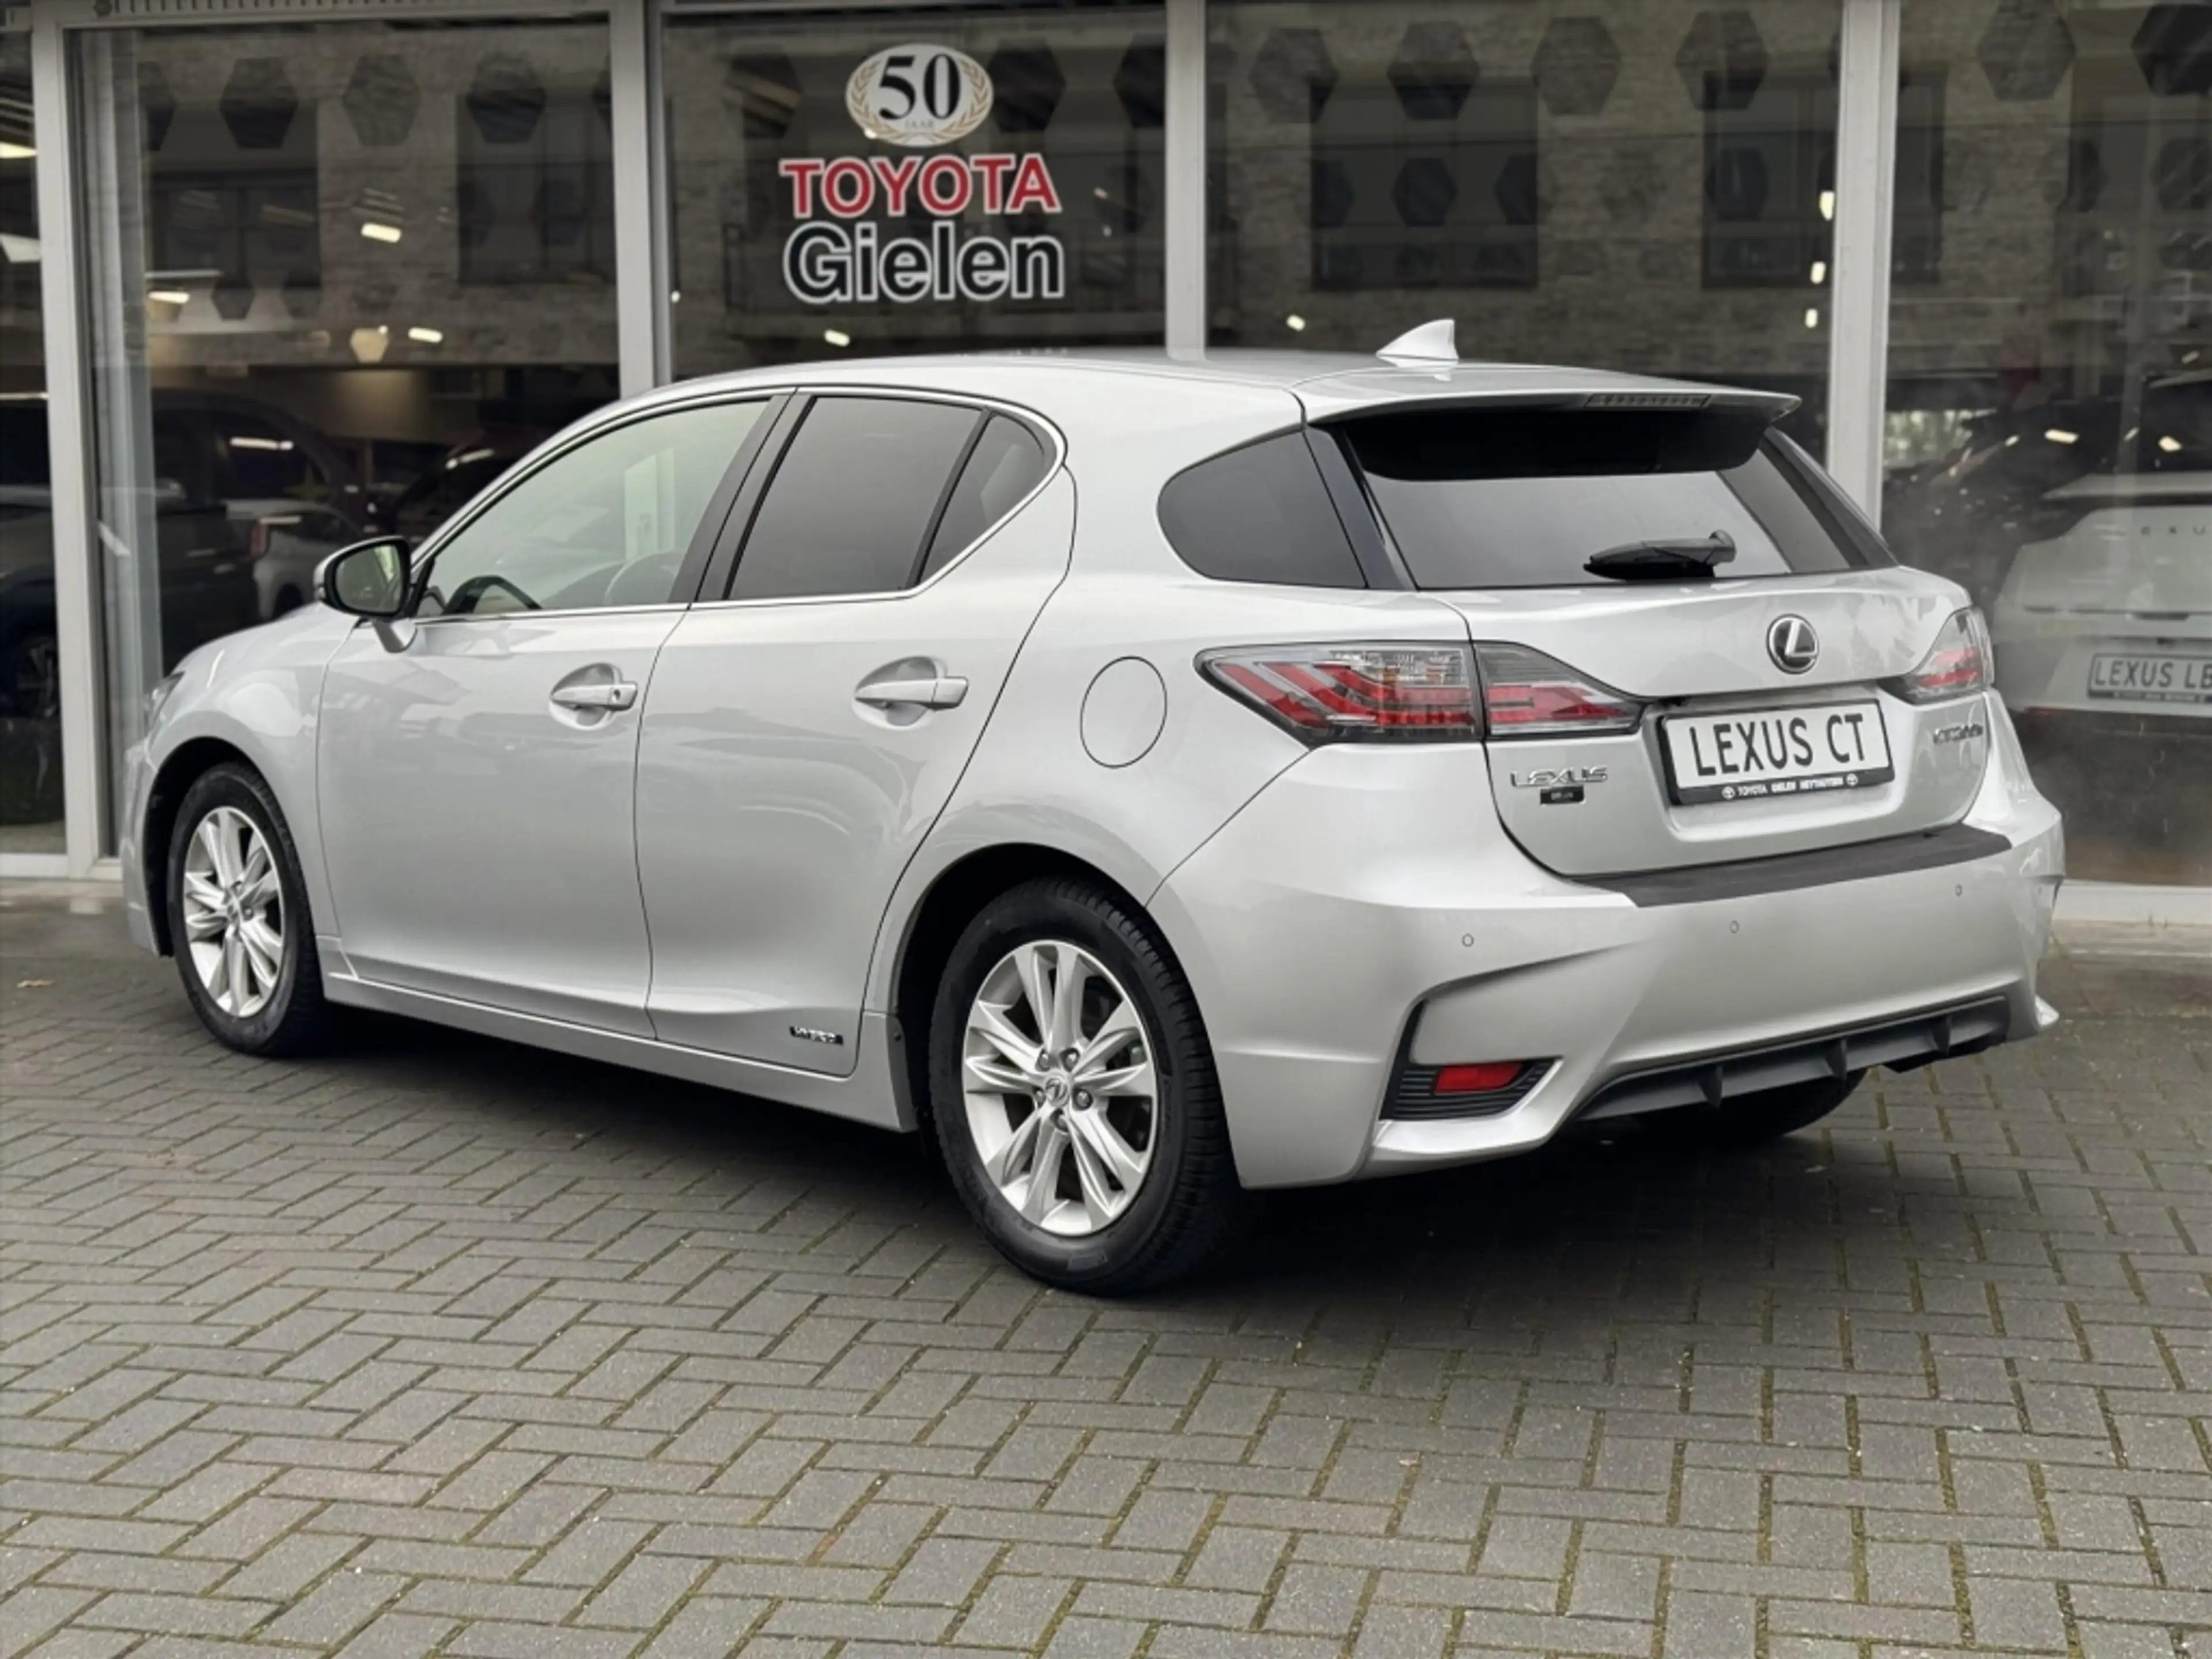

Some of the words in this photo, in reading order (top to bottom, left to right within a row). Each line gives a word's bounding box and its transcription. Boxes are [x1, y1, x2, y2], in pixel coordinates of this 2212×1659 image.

[878, 54, 961, 120] 50
[779, 154, 1062, 218] TOYOTA
[783, 220, 1065, 304] Gielen
[2094, 661, 2174, 688] LEXUS
[1510, 764, 1608, 787] LEXUS
[1689, 717, 1813, 777] LEXUS
[1826, 713, 1865, 763] CT
